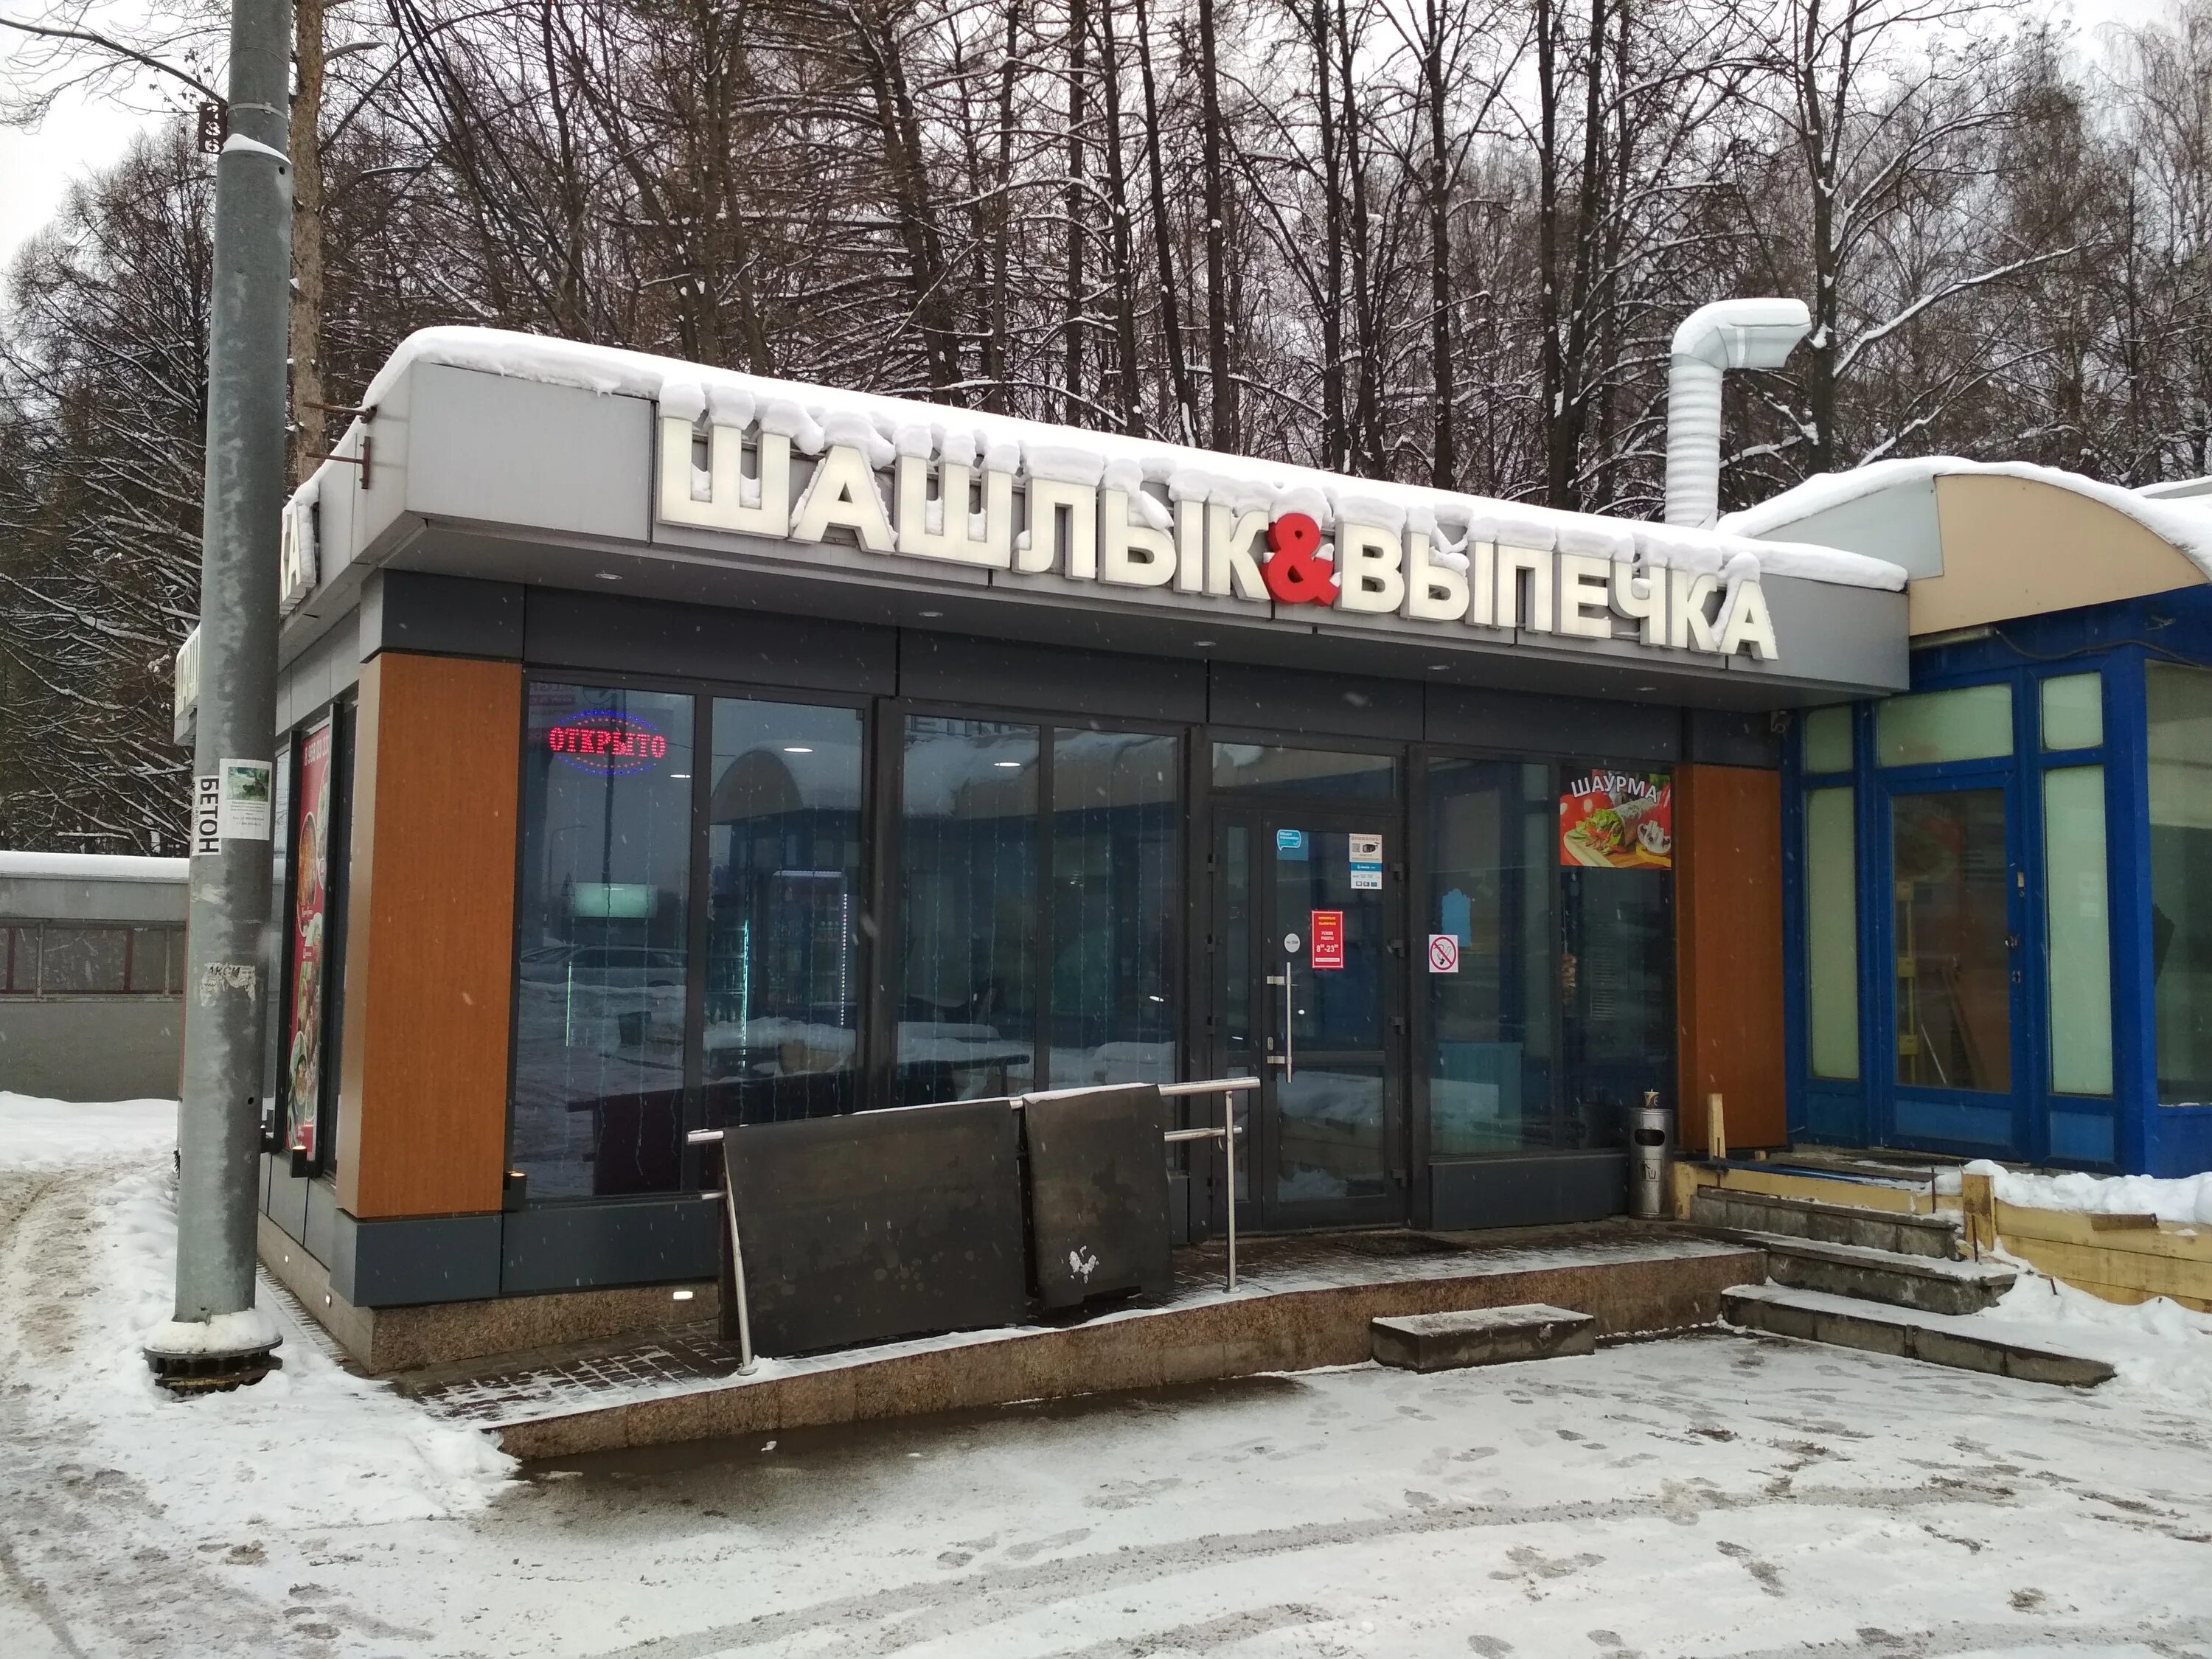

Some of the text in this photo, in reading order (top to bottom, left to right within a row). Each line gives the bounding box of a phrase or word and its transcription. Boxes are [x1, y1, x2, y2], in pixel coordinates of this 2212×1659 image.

[657, 417, 1270, 602] ШАШЛЫК
[1334, 521, 1778, 660] ВЫПЕЧКА
[549, 727, 667, 758] ОТКРЫТО
[198, 778, 219, 852] БЕТОН
[1571, 776, 1658, 803] ШАУРМА
